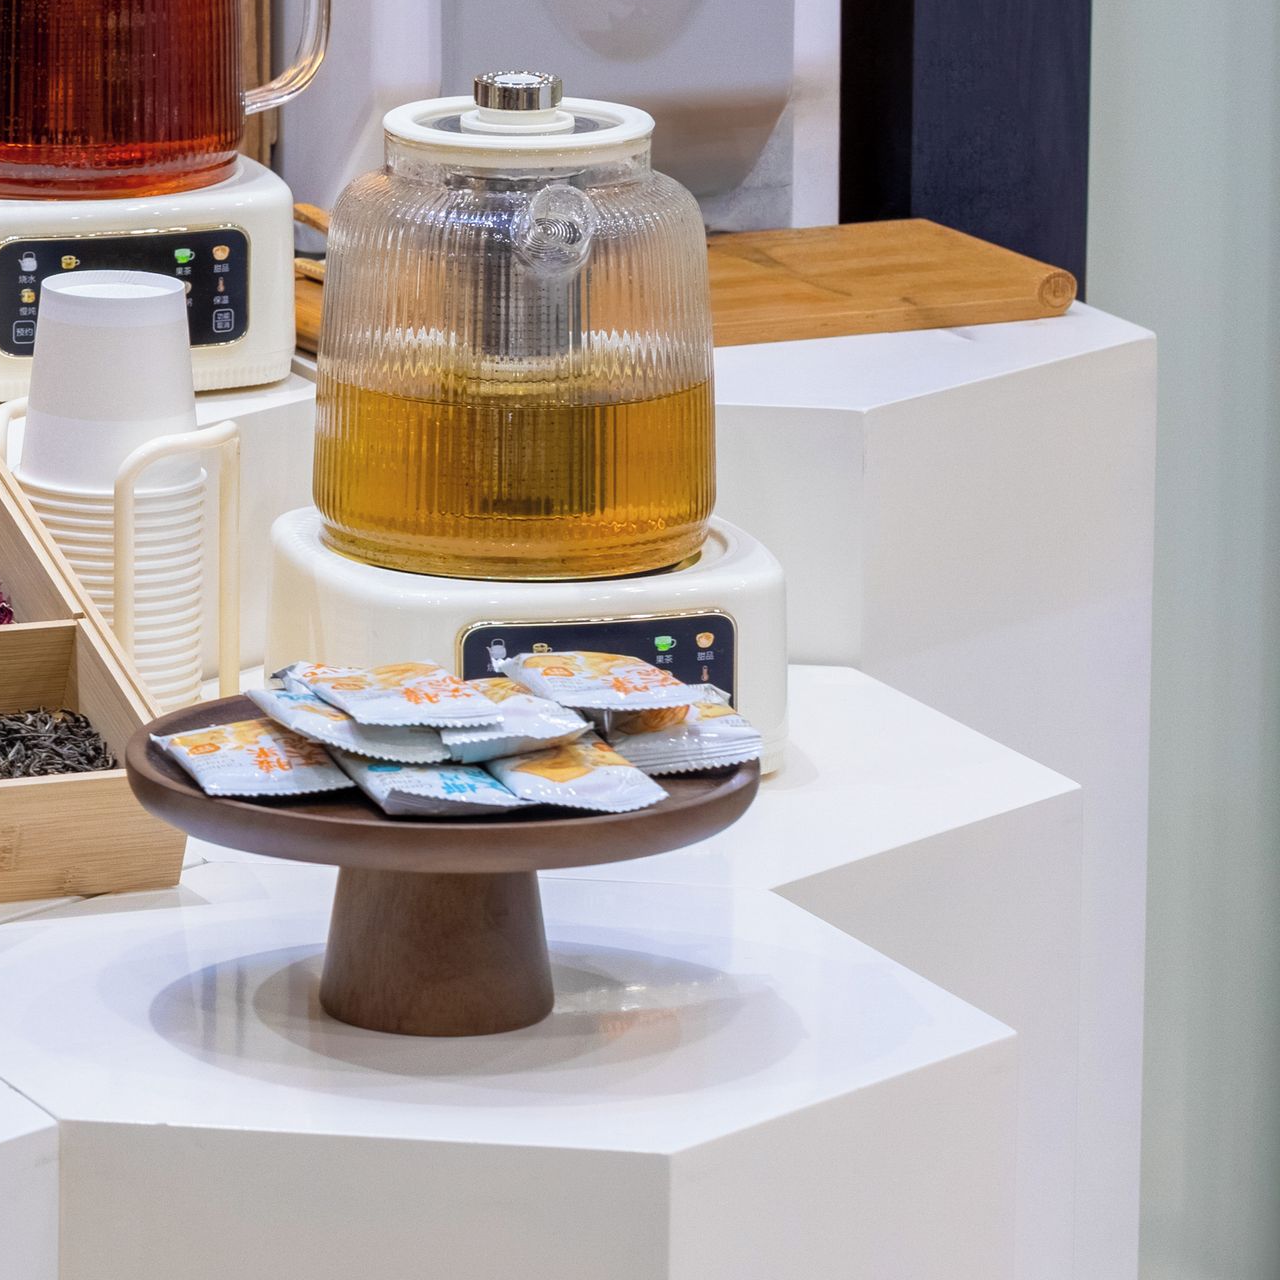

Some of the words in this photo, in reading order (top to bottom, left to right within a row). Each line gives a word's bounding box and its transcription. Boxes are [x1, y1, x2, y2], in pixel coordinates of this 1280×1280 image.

[18, 275, 36, 285] 烧水
[213, 295, 230, 305] 保温
[16, 327, 34, 337] 预约
[655, 654, 673, 664] 果茶
[697, 651, 715, 661] 甜品
